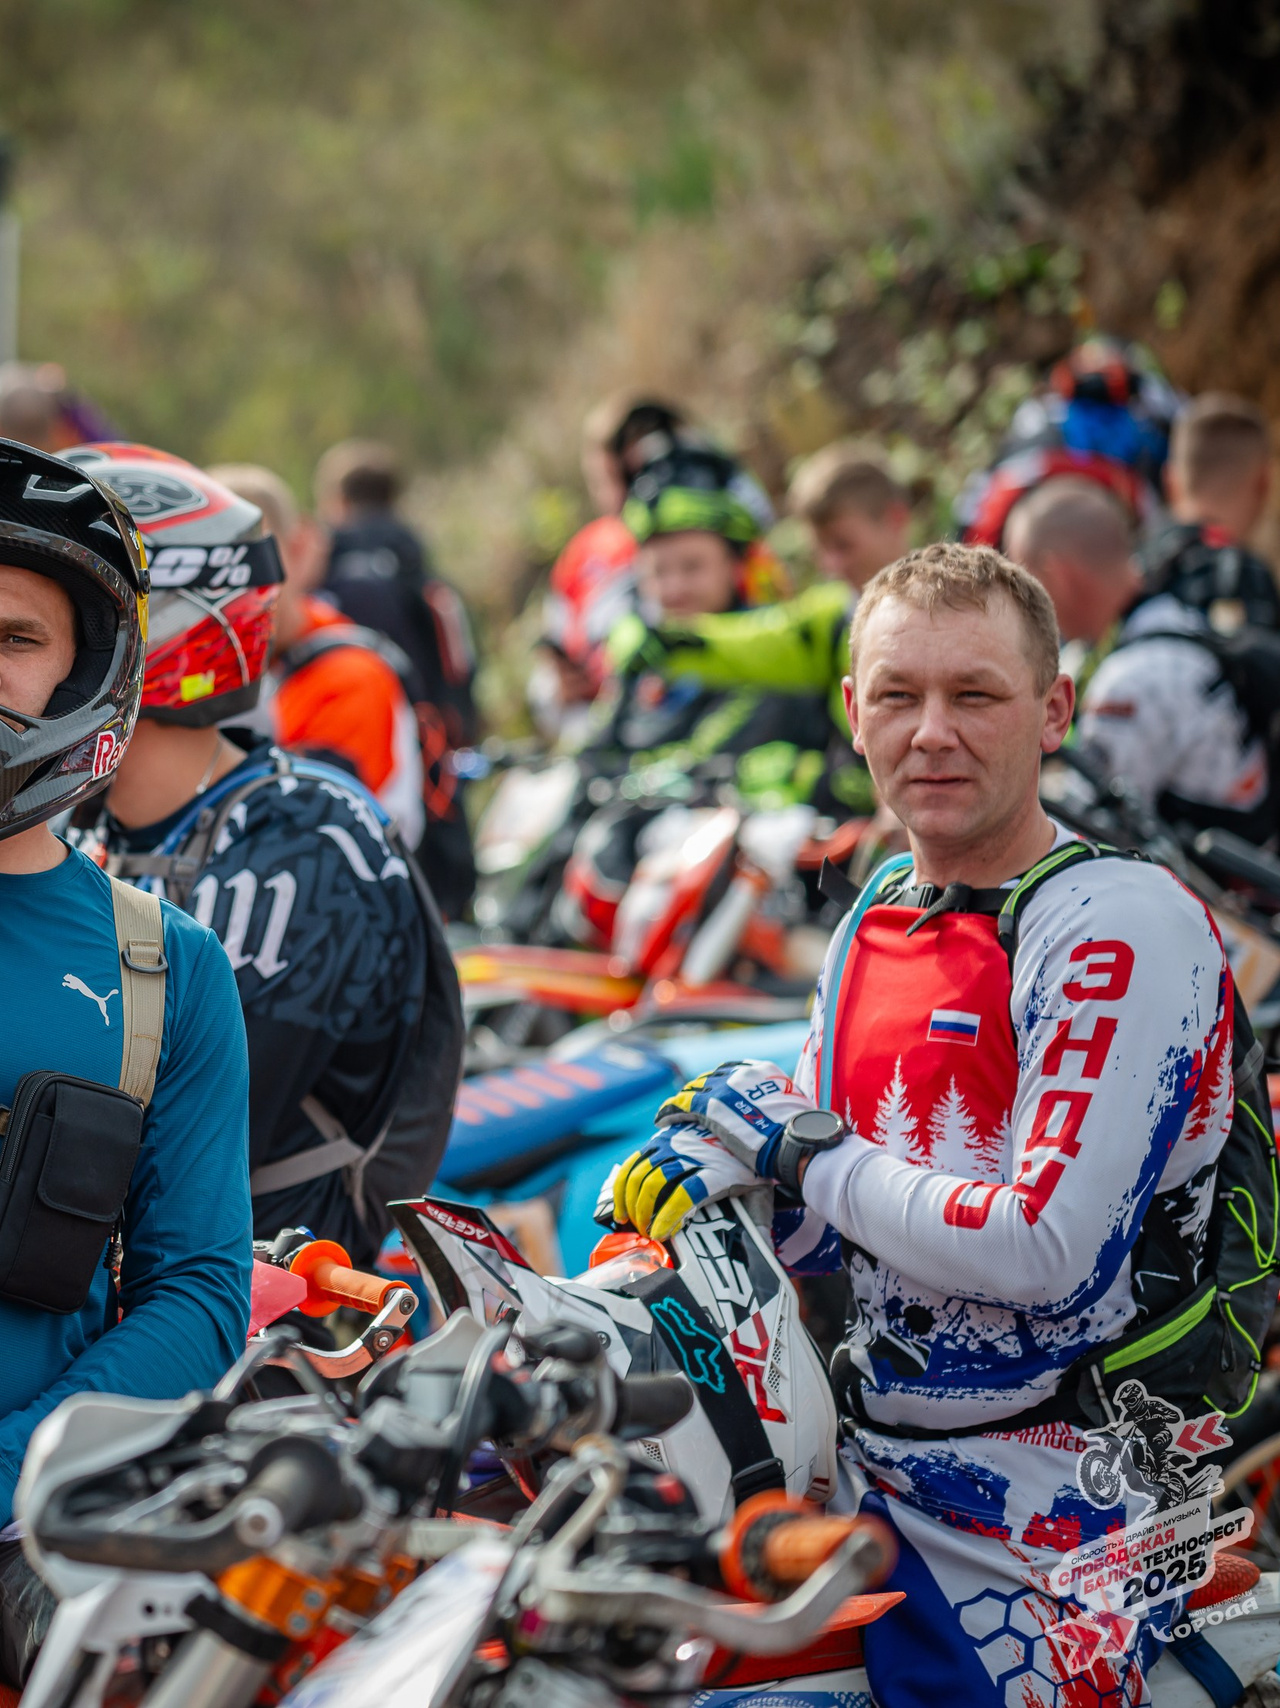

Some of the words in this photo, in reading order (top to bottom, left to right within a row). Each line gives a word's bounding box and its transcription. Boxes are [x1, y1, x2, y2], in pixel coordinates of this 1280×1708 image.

[145, 545, 252, 588] 0%
[943, 939, 1136, 1230] ЭНДУО
[734, 1100, 770, 1130] HIZER
